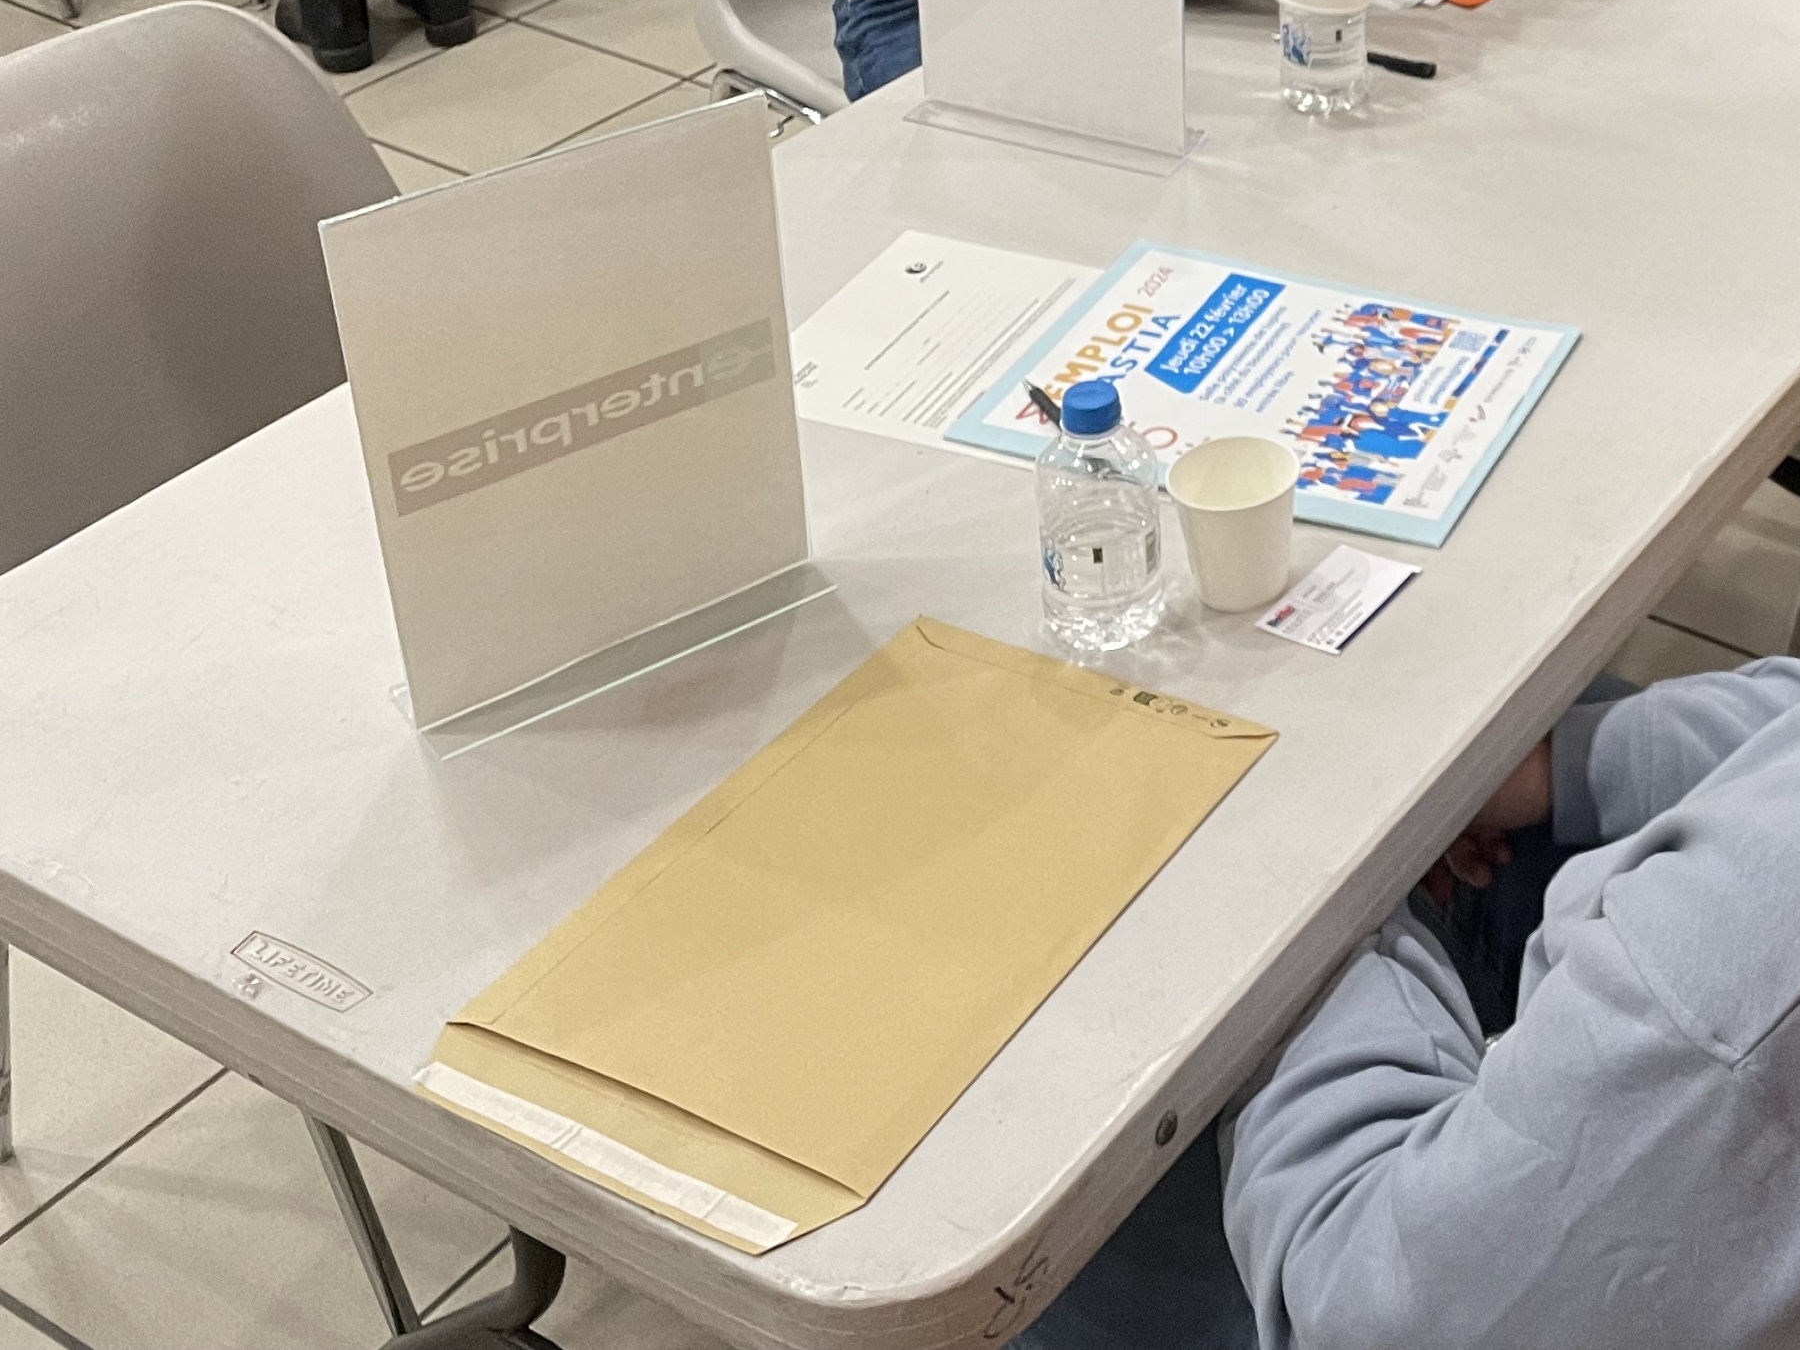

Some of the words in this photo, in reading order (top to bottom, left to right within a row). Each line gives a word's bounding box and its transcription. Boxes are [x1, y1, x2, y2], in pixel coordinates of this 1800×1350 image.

[1098, 313, 1182, 386] ASTIA
[1160, 335, 1198, 374] Jeudi
[1189, 317, 1214, 338] 22
[251, 941, 355, 1005] LIFETIME
